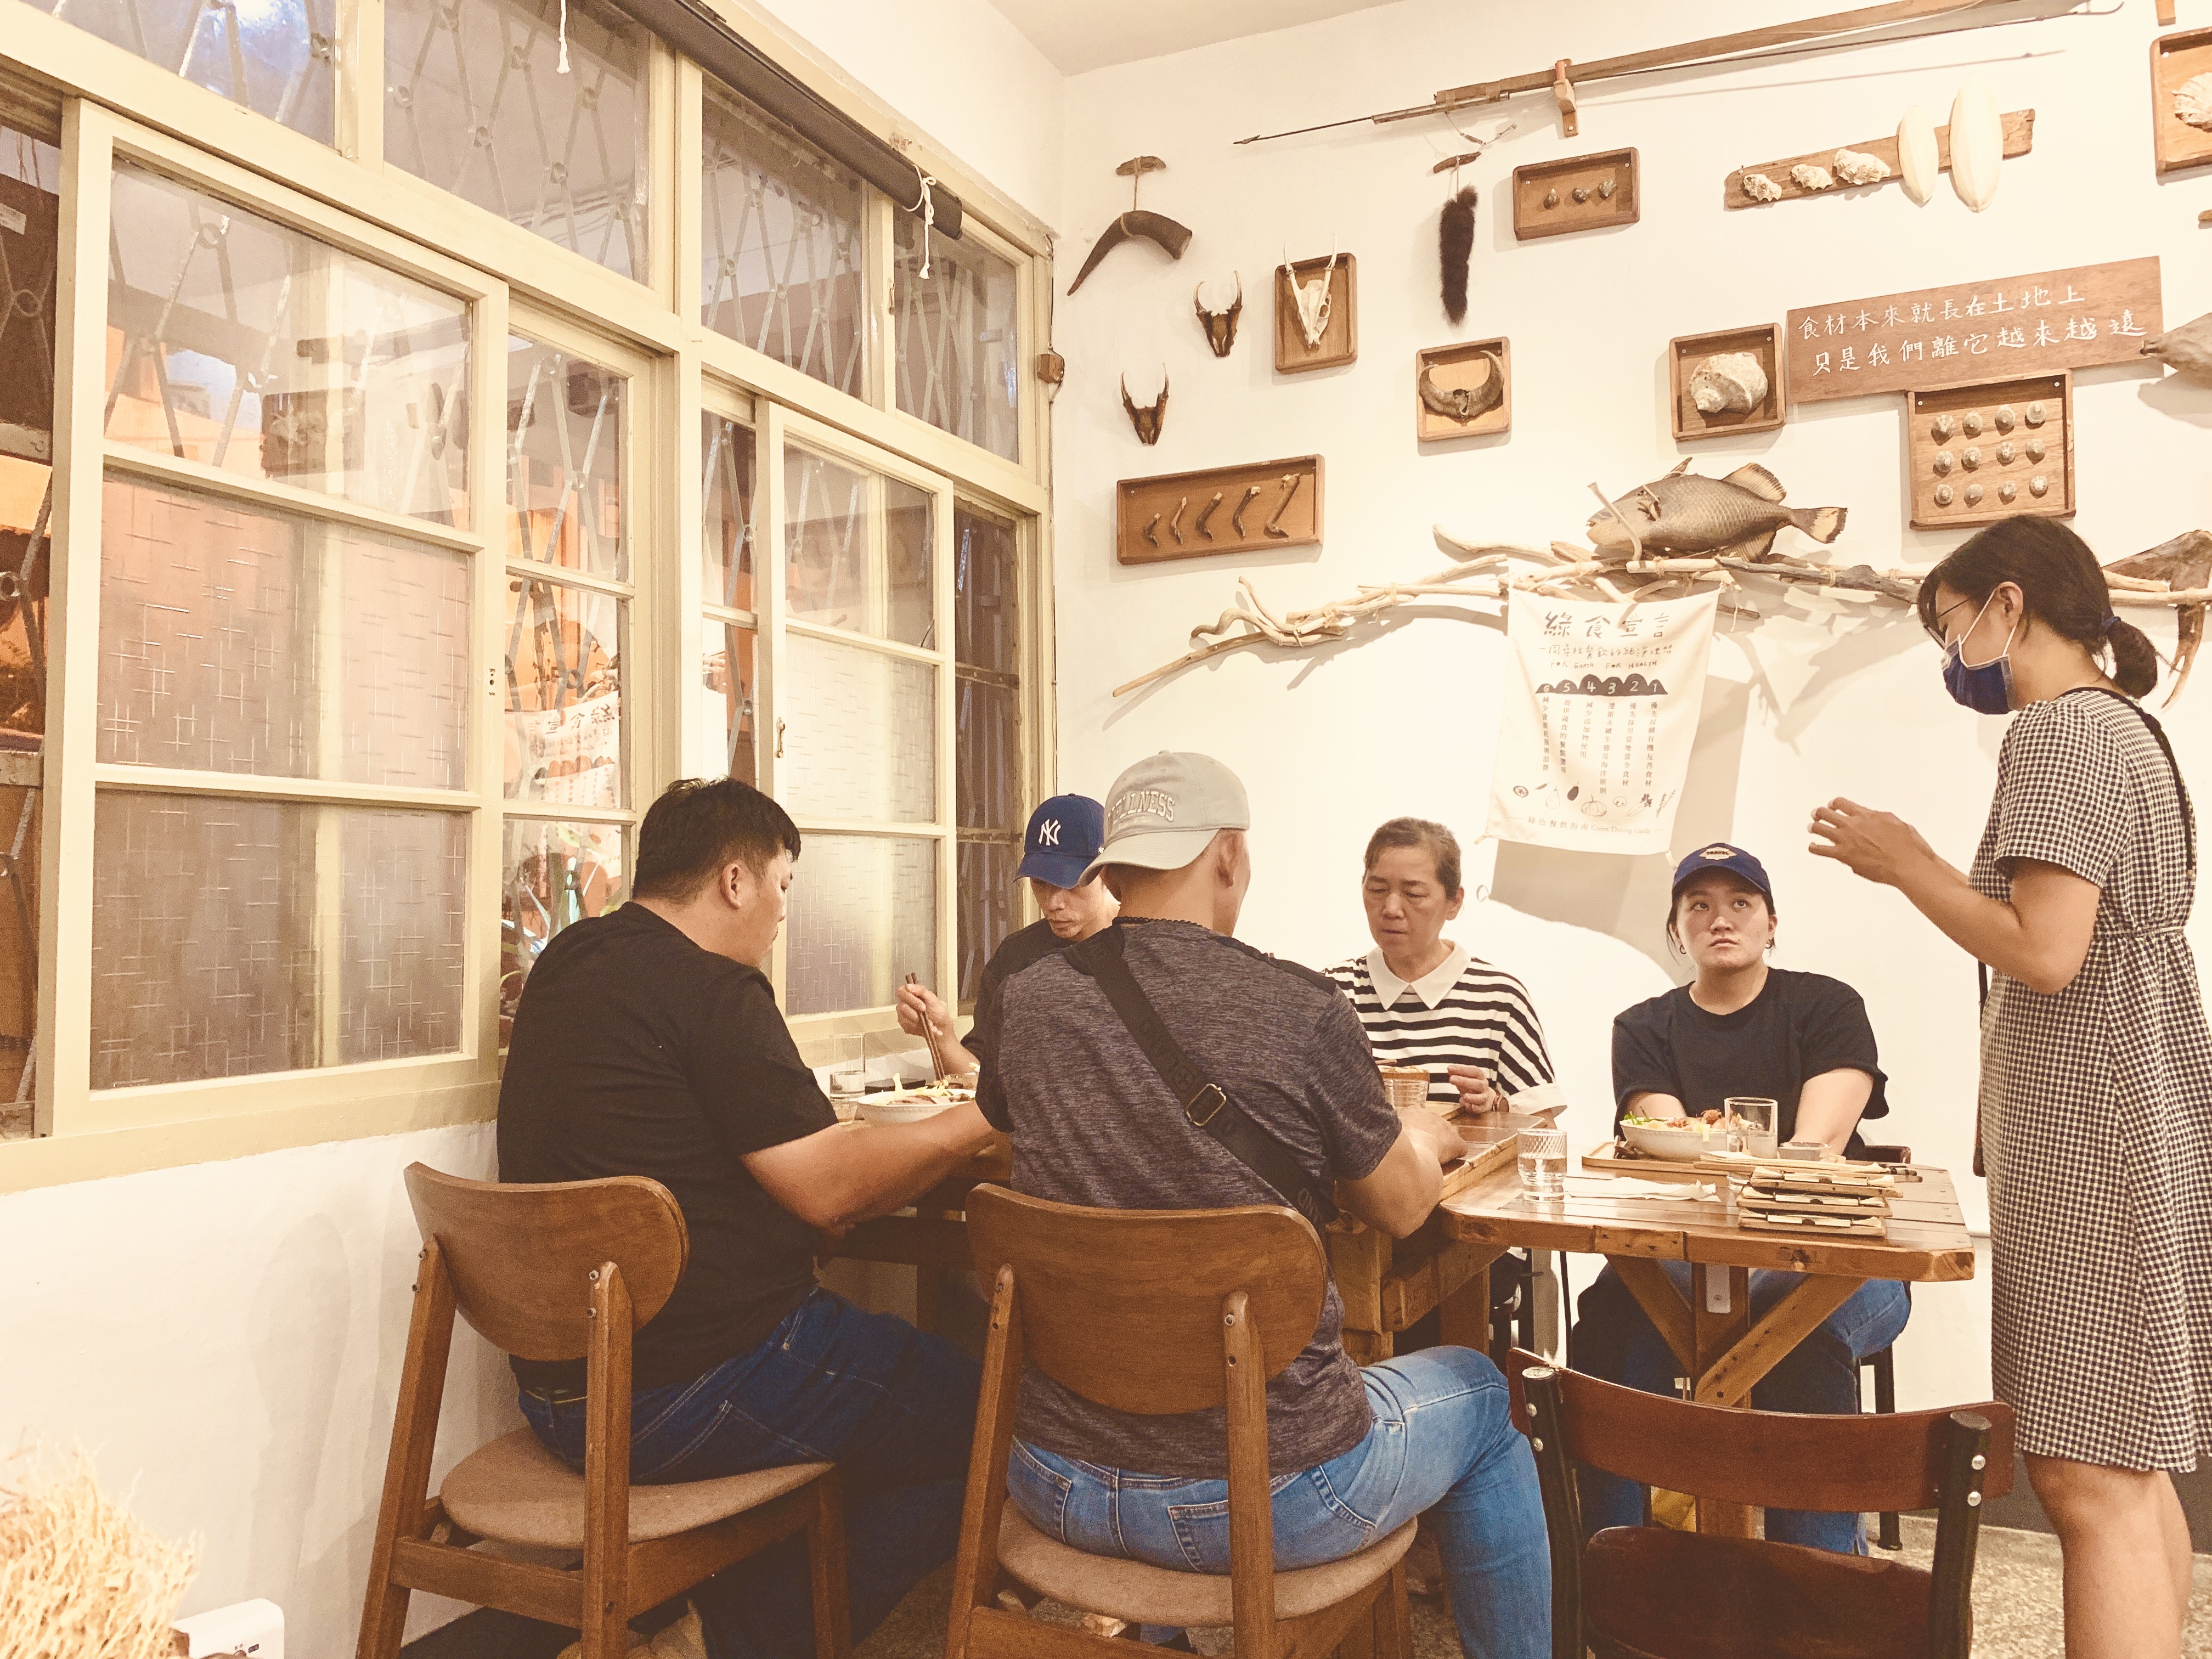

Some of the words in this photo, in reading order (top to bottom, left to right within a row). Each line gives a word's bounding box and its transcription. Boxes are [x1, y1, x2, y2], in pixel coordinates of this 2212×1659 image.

[1798, 285, 2085, 340] 食材本來就長在土地上
[1813, 309, 2148, 376] 只是我們離它越來越遠
[1544, 611, 1670, 639] 綠食宣言
[1551, 659, 1567, 668] FOR
[1628, 660, 1657, 669] HEALTH
[1563, 682, 1571, 692] 5
[1587, 680, 1596, 692] 4
[1607, 682, 1617, 695] 3
[1629, 680, 1639, 692] 2
[1653, 682, 1658, 692] 1
[1039, 819, 1061, 845] NY
[1590, 824, 1610, 832] Green
[1611, 826, 1633, 835] Dining
